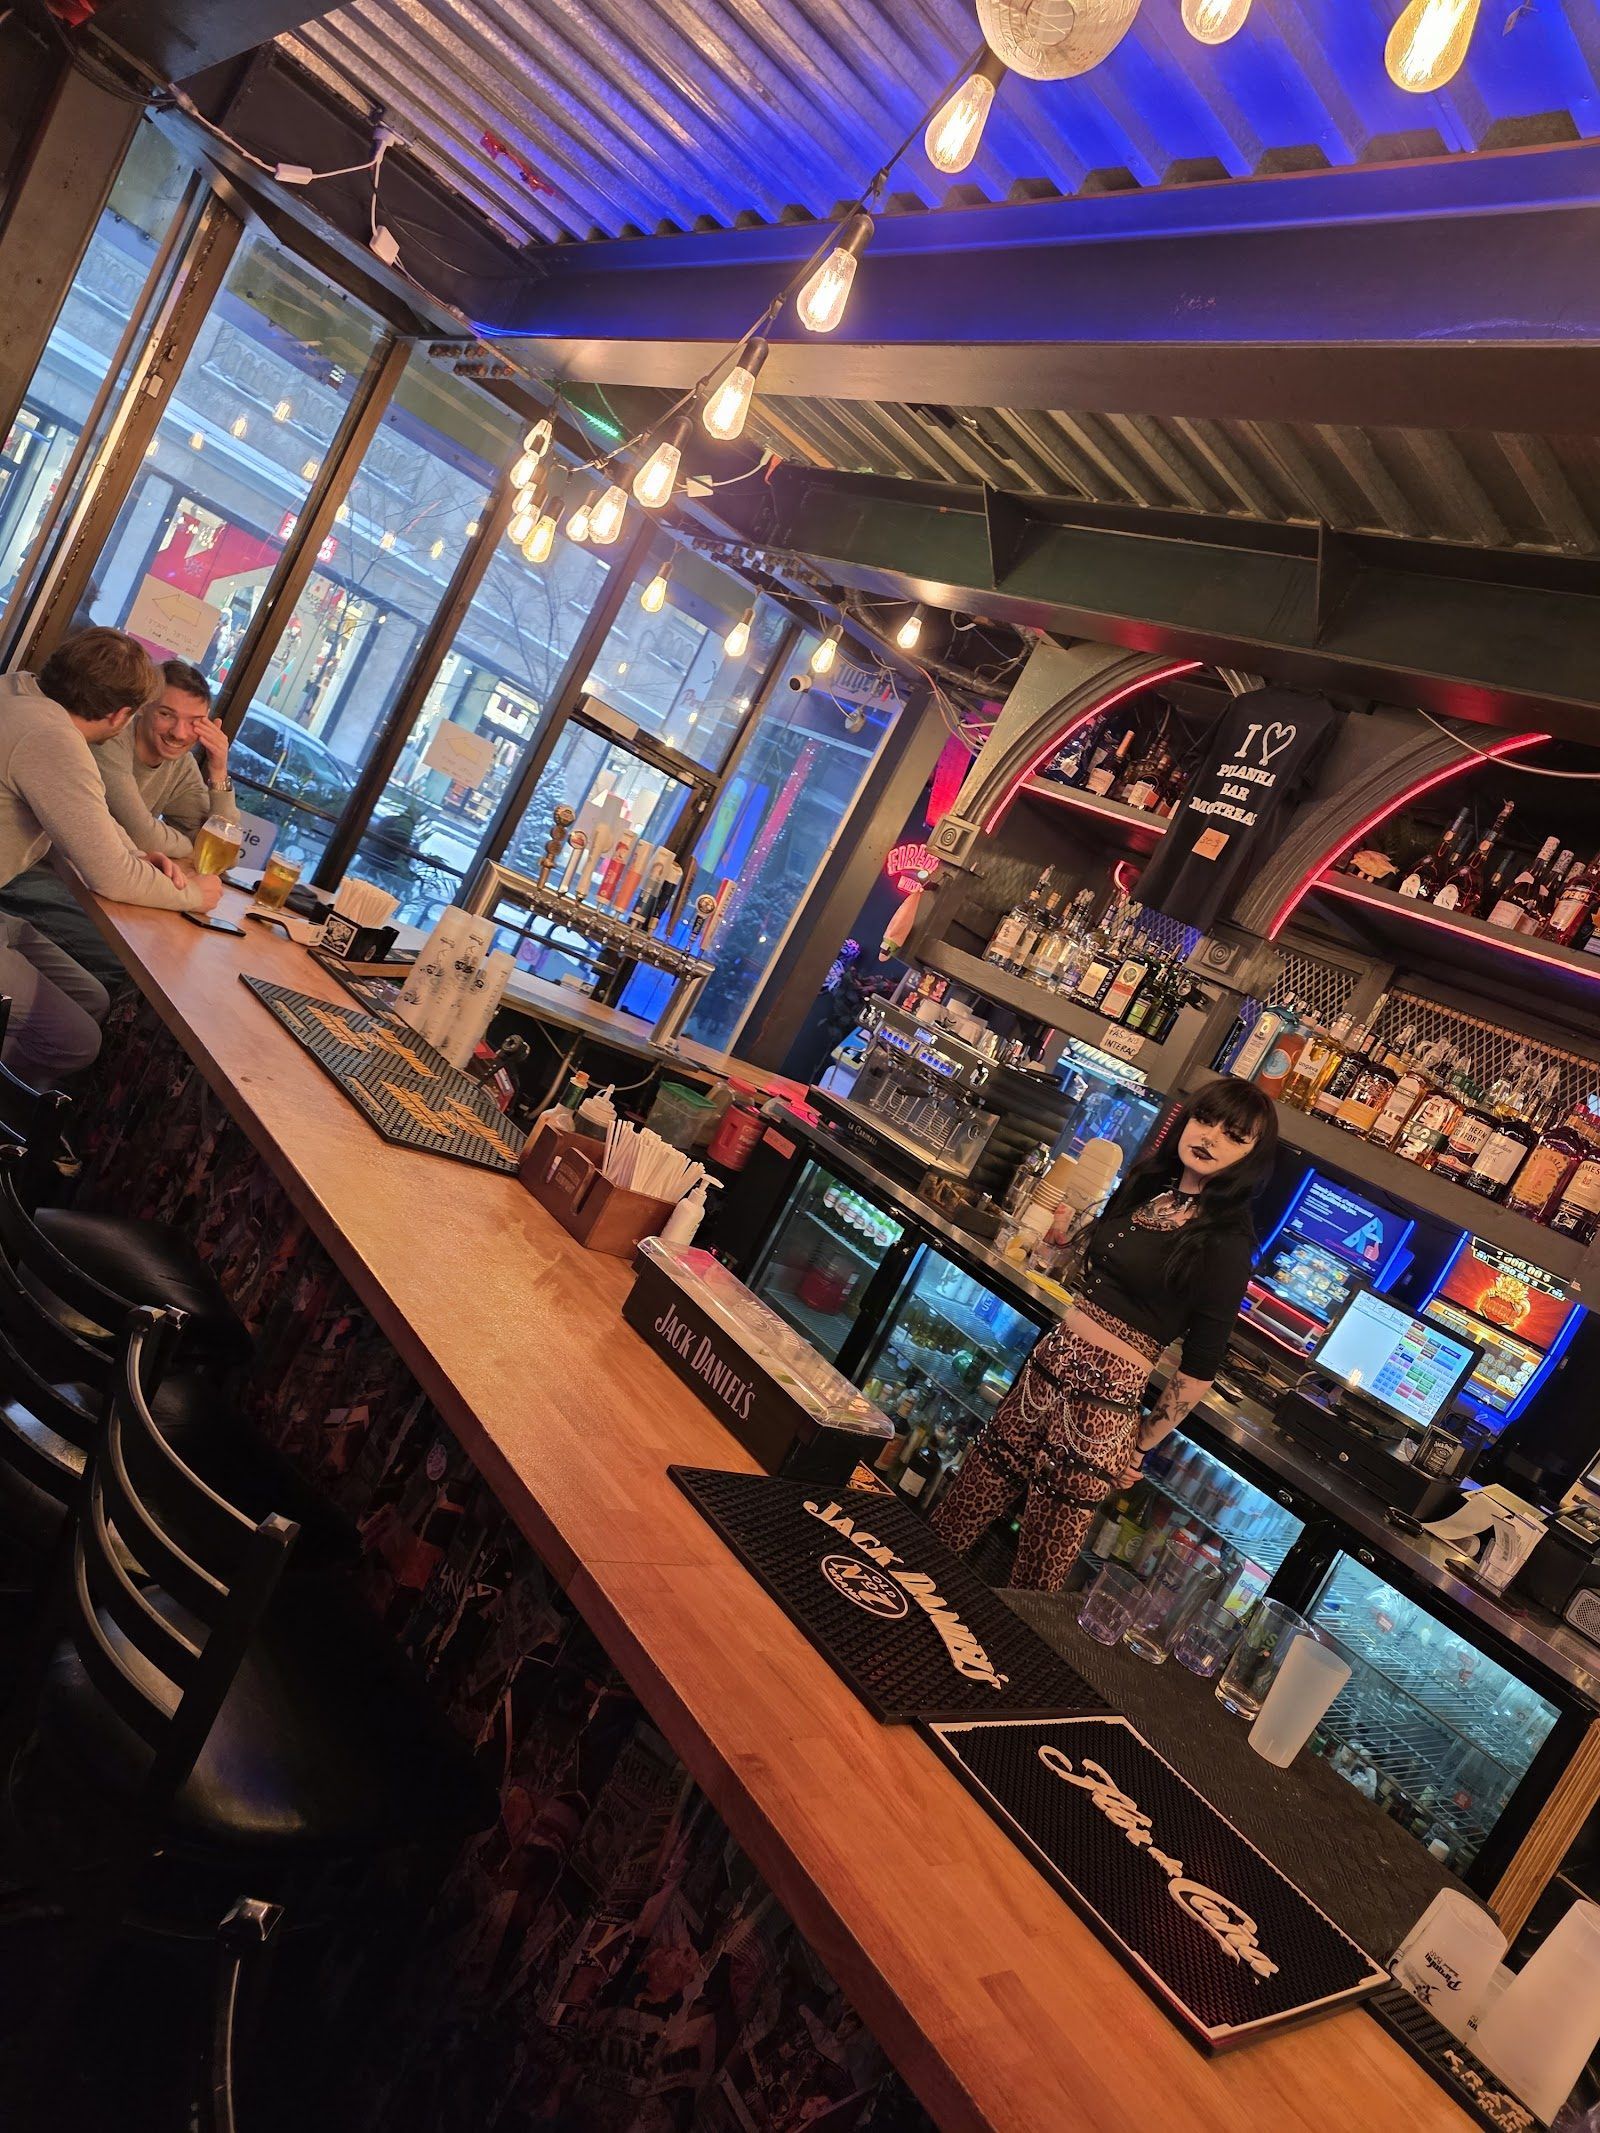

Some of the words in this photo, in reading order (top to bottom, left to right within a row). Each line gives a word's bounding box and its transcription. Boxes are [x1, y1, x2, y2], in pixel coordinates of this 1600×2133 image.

[1234, 724, 1262, 758] I
[654, 1303, 697, 1360] JACK
[690, 1335, 756, 1420] DANIEL'S
[803, 1500, 904, 1568] JACK
[888, 1569, 1009, 1690] DANIEL'S
[872, 1575, 897, 1599] OLD
[1038, 1745, 1153, 1847] Flor
[1147, 1846, 1184, 1878] de
